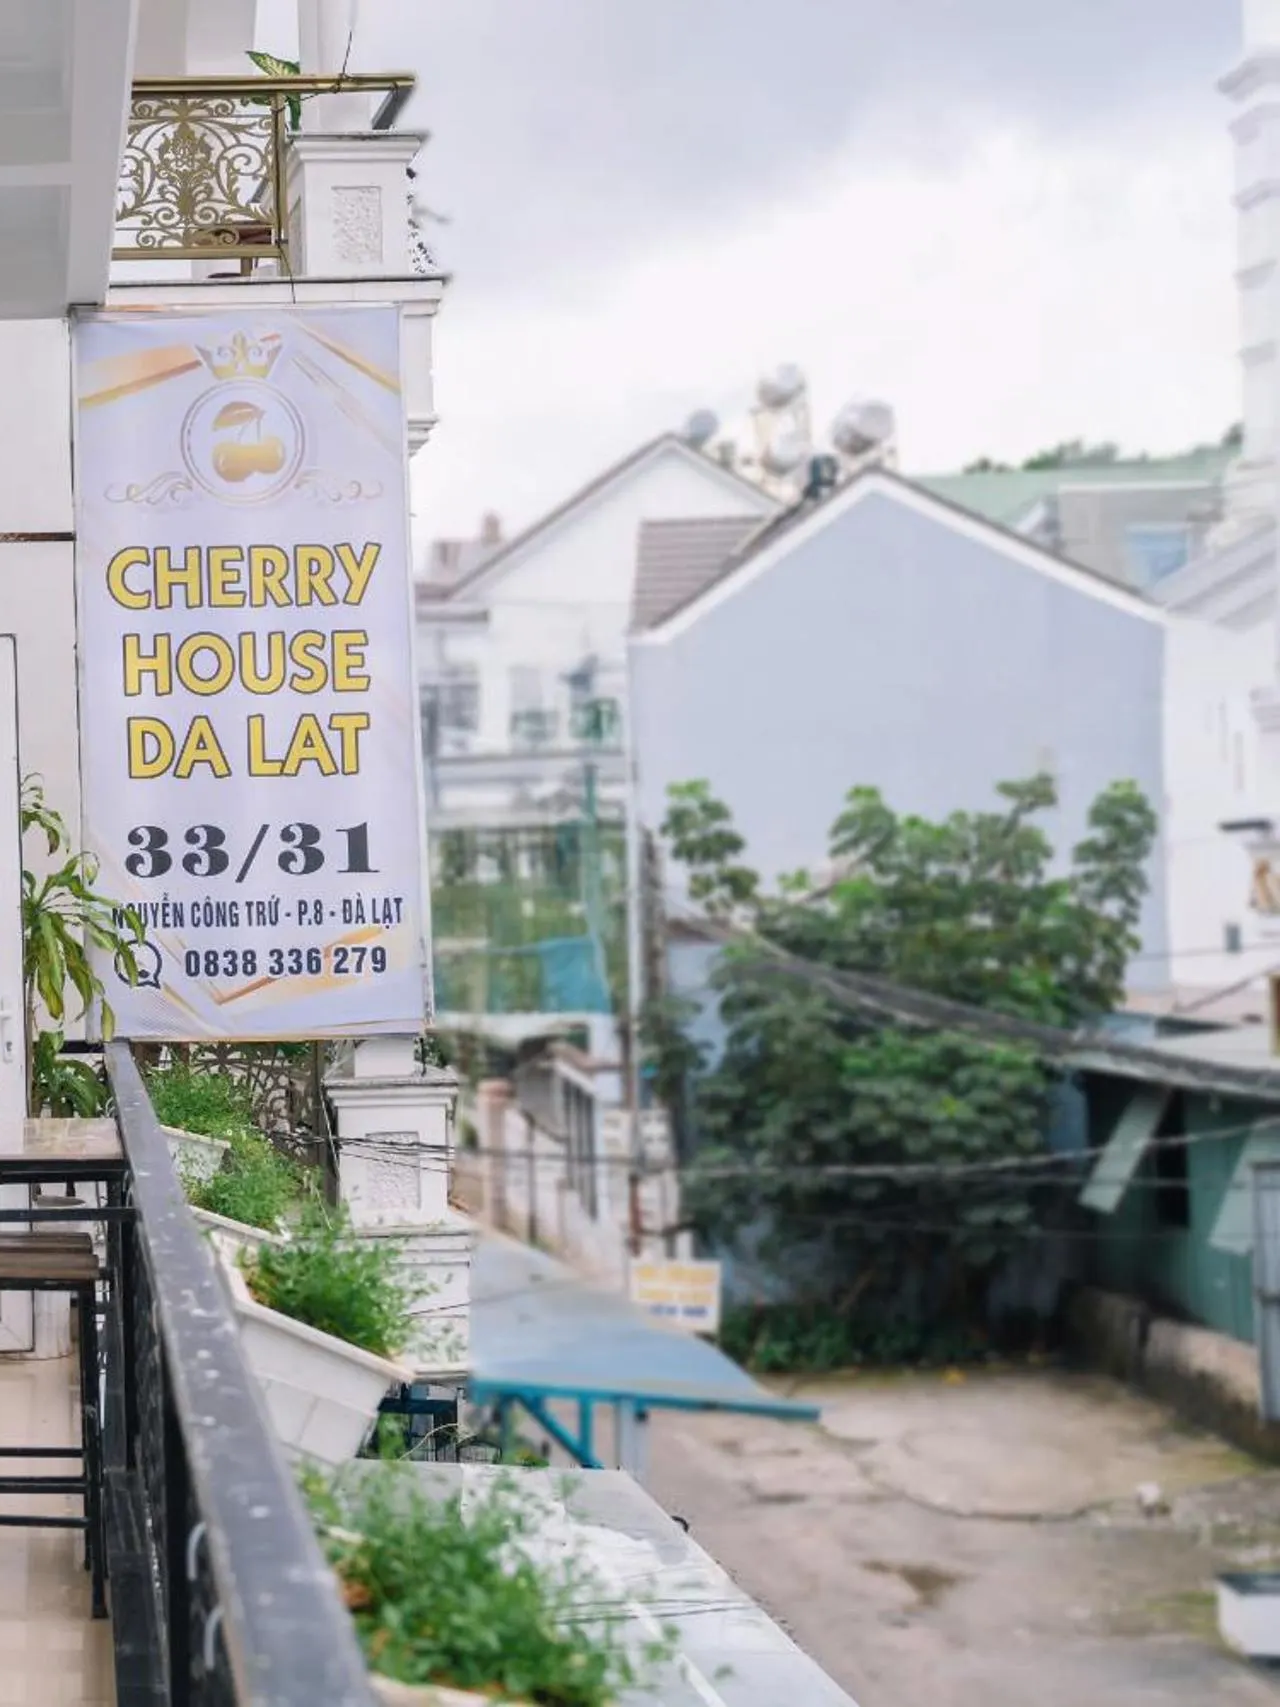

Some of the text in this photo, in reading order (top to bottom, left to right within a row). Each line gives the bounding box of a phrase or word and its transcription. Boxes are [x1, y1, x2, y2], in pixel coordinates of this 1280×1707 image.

[106, 542, 382, 610] CHERRY
[122, 630, 371, 696] HOUSE
[127, 713, 370, 779] DA LAT
[125, 821, 381, 883] 33/31
[190, 895, 240, 927] CÔNG
[245, 895, 280, 926] TRỨ
[298, 899, 323, 926] P.8
[342, 892, 366, 924] ĐÀ
[372, 897, 403, 929] LẠT
[185, 946, 387, 977] 0838 336 279
